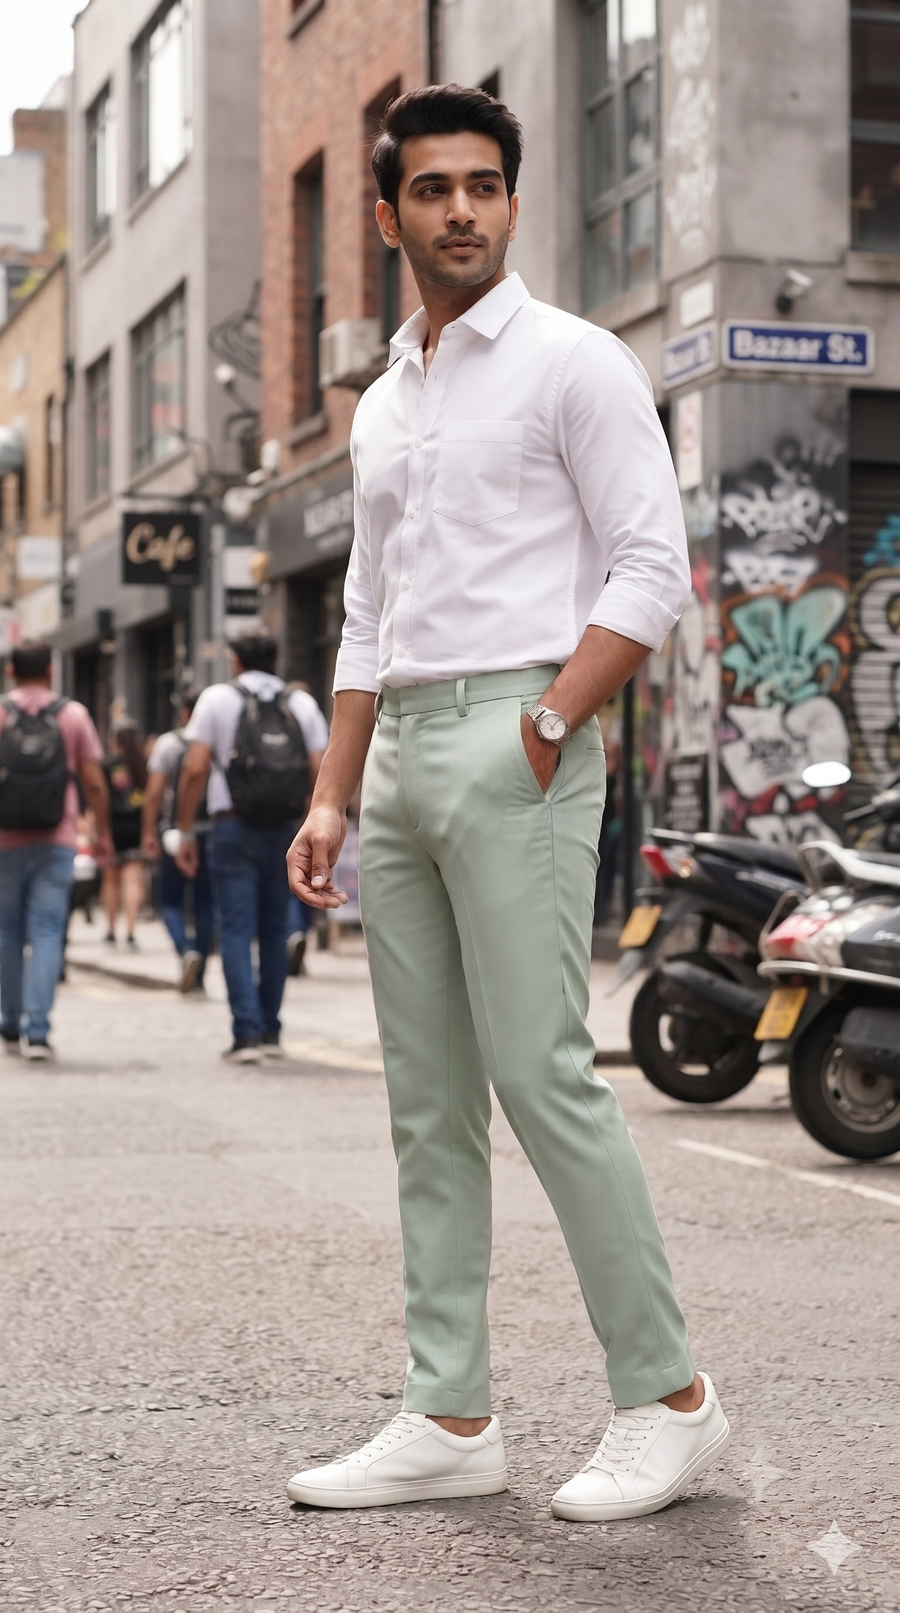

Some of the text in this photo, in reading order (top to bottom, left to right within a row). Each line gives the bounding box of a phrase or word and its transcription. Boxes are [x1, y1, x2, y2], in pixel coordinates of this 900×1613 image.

[733, 328, 822, 361] Bazaar
[826, 332, 863, 363] St.
[126, 521, 197, 572] Cafe
